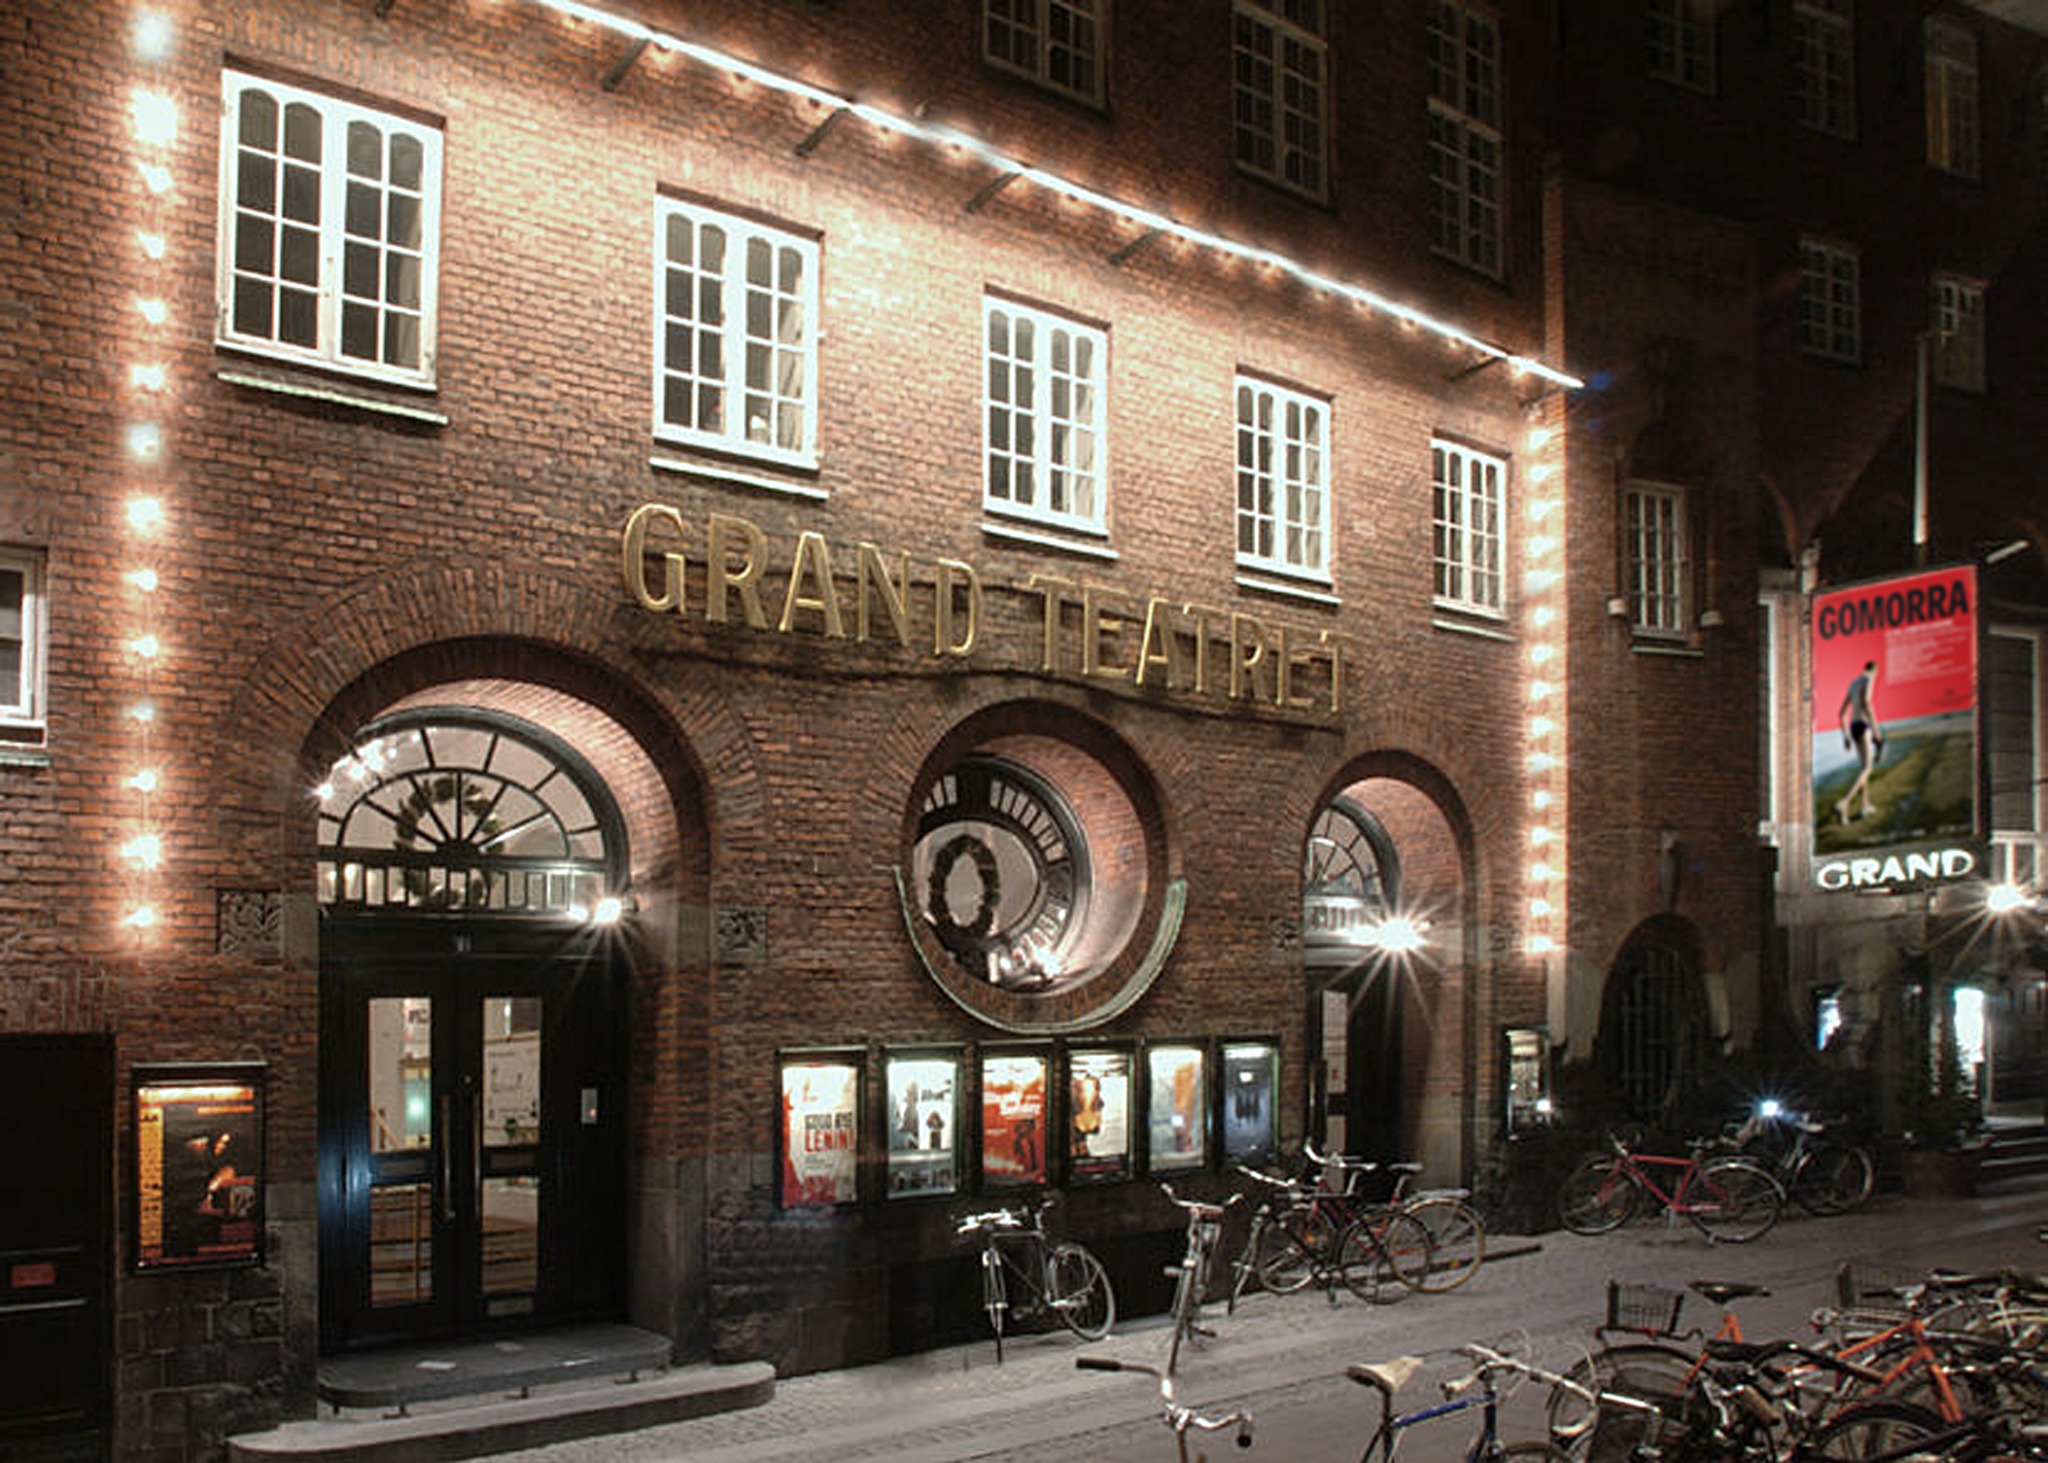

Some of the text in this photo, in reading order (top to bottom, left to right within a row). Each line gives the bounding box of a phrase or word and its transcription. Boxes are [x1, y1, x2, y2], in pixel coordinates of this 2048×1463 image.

[623, 503, 1350, 714] GRAND TEATRET
[1819, 581, 1969, 639] GOMORRA
[1816, 849, 1974, 890] GRAND
